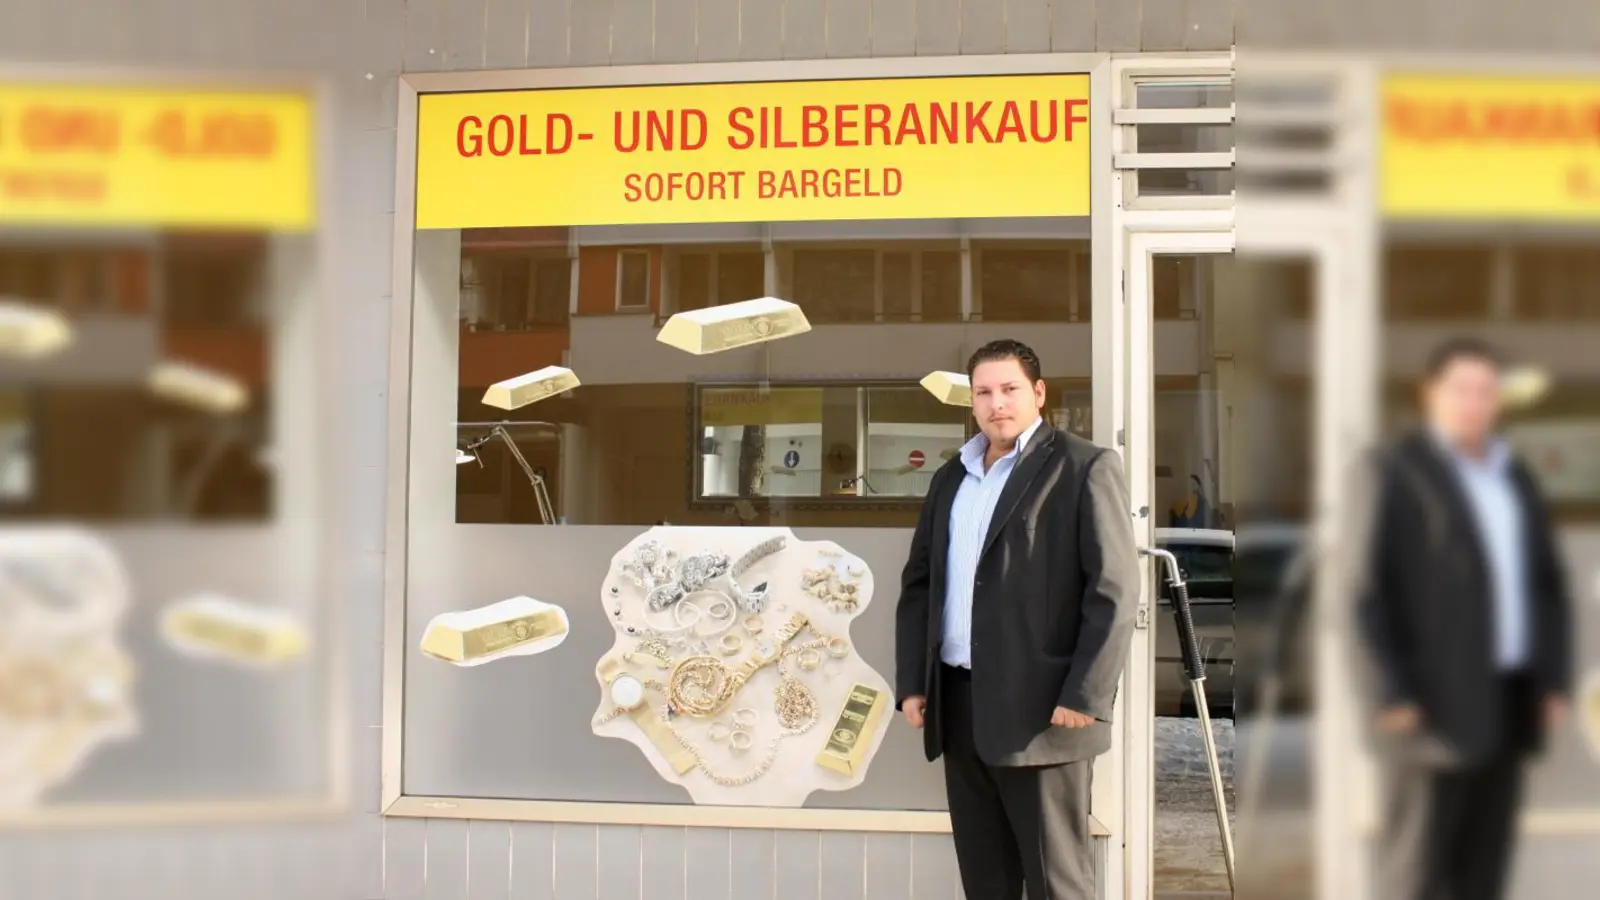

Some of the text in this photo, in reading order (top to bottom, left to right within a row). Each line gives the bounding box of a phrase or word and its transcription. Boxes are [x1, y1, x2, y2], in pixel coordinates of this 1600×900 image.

[456, 98, 1090, 158] GOLD- UND SILBERANKAUF
[623, 167, 903, 203] SOFORT BARGELD
